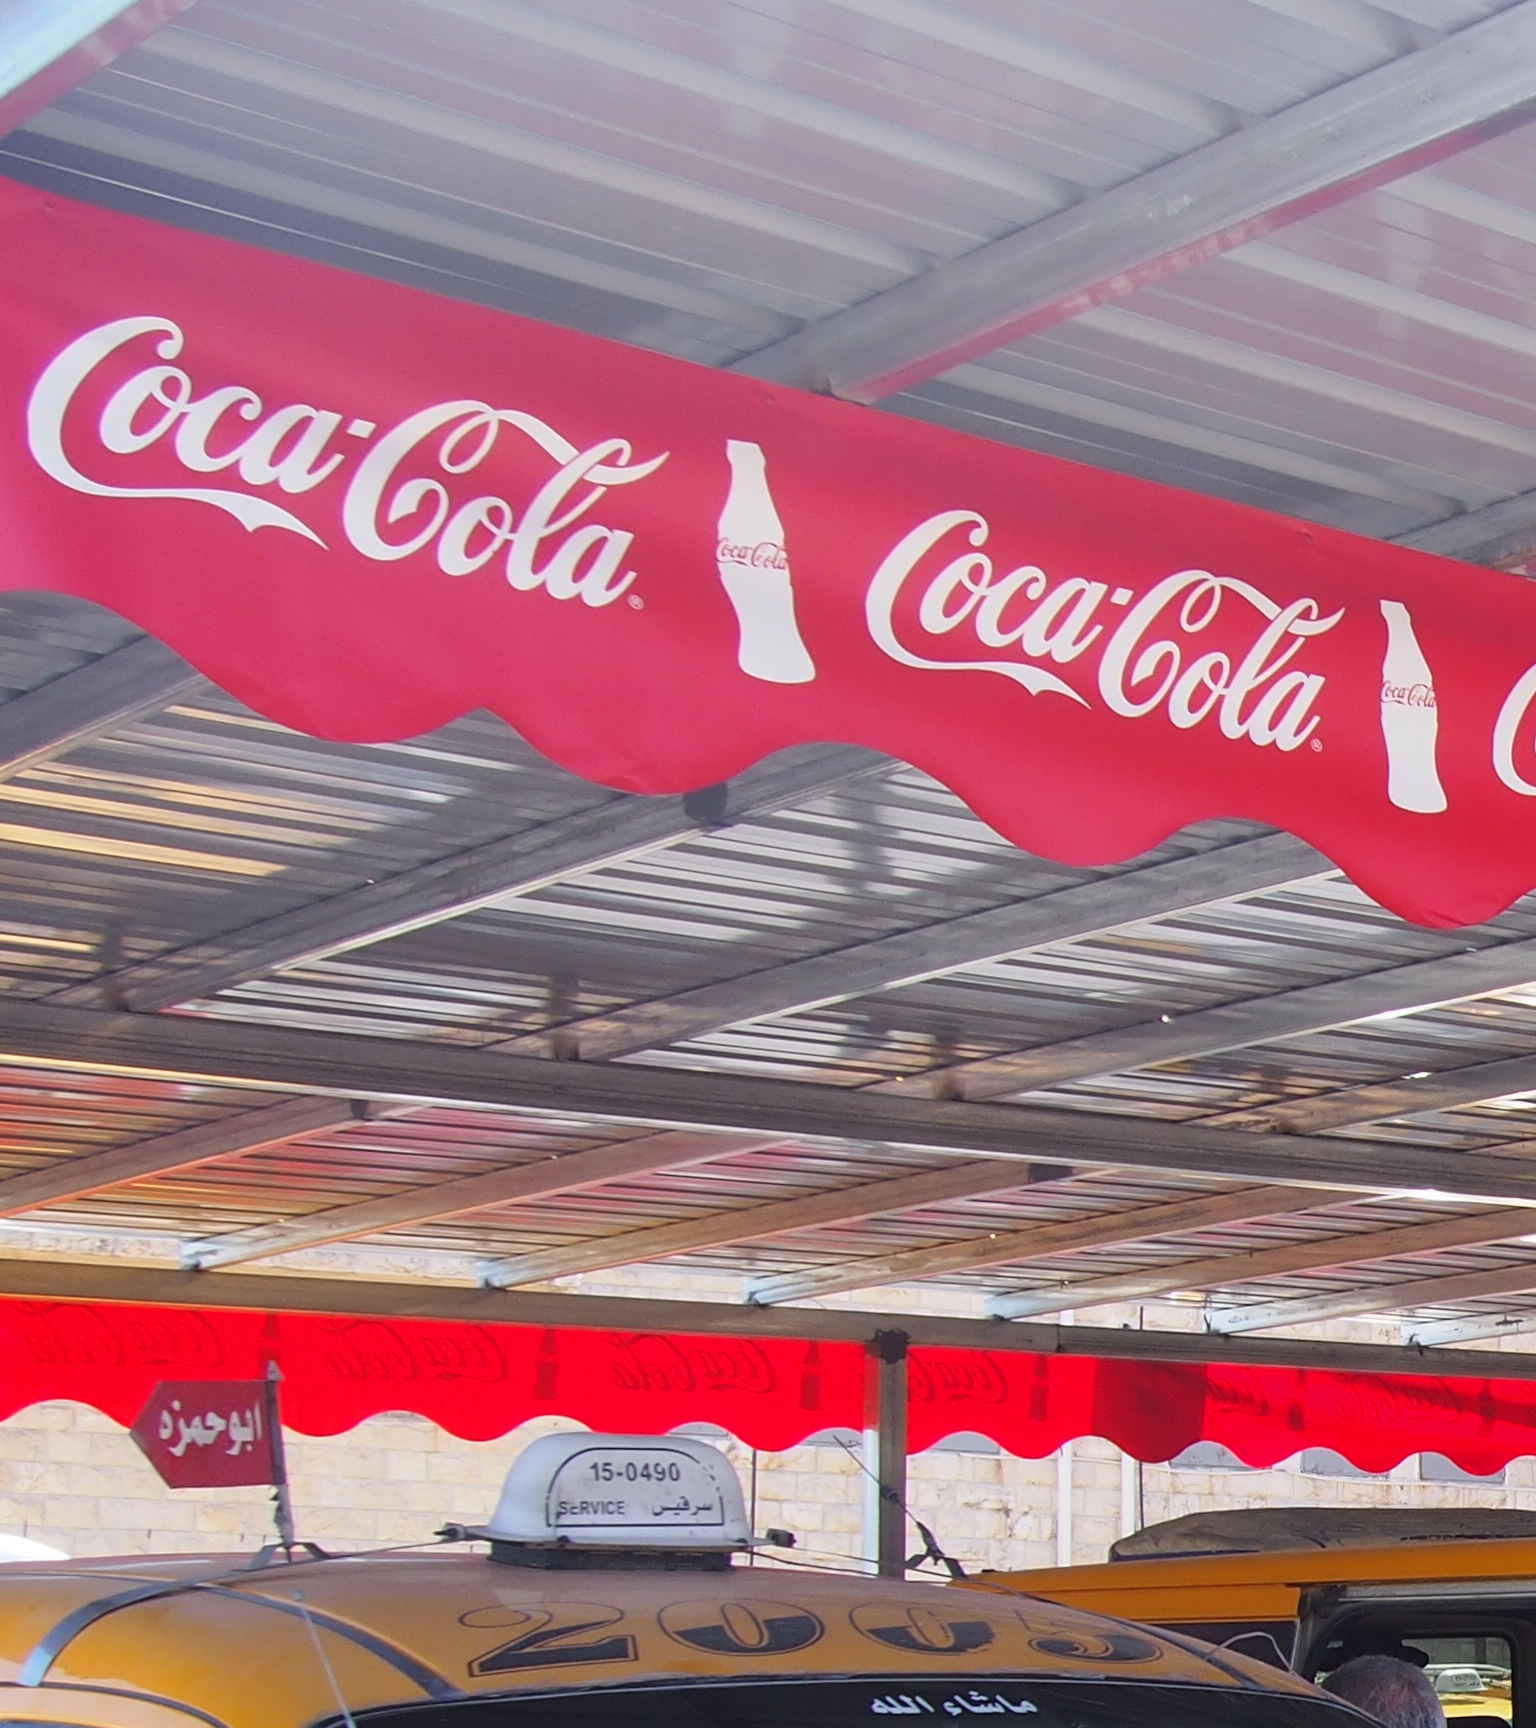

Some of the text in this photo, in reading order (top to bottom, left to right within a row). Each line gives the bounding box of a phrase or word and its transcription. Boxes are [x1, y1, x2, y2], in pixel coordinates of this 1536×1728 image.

[27, 316, 669, 608] Coca-Cola
[716, 537, 788, 571] Coca-Cola
[866, 510, 1345, 752] Coca-Cola
[1381, 679, 1436, 708] Coca-Cola
[589, 1462, 681, 1482] 15-0490
[458, 1601, 1165, 1678] 2005
[871, 1694, 935, 1715] الله
